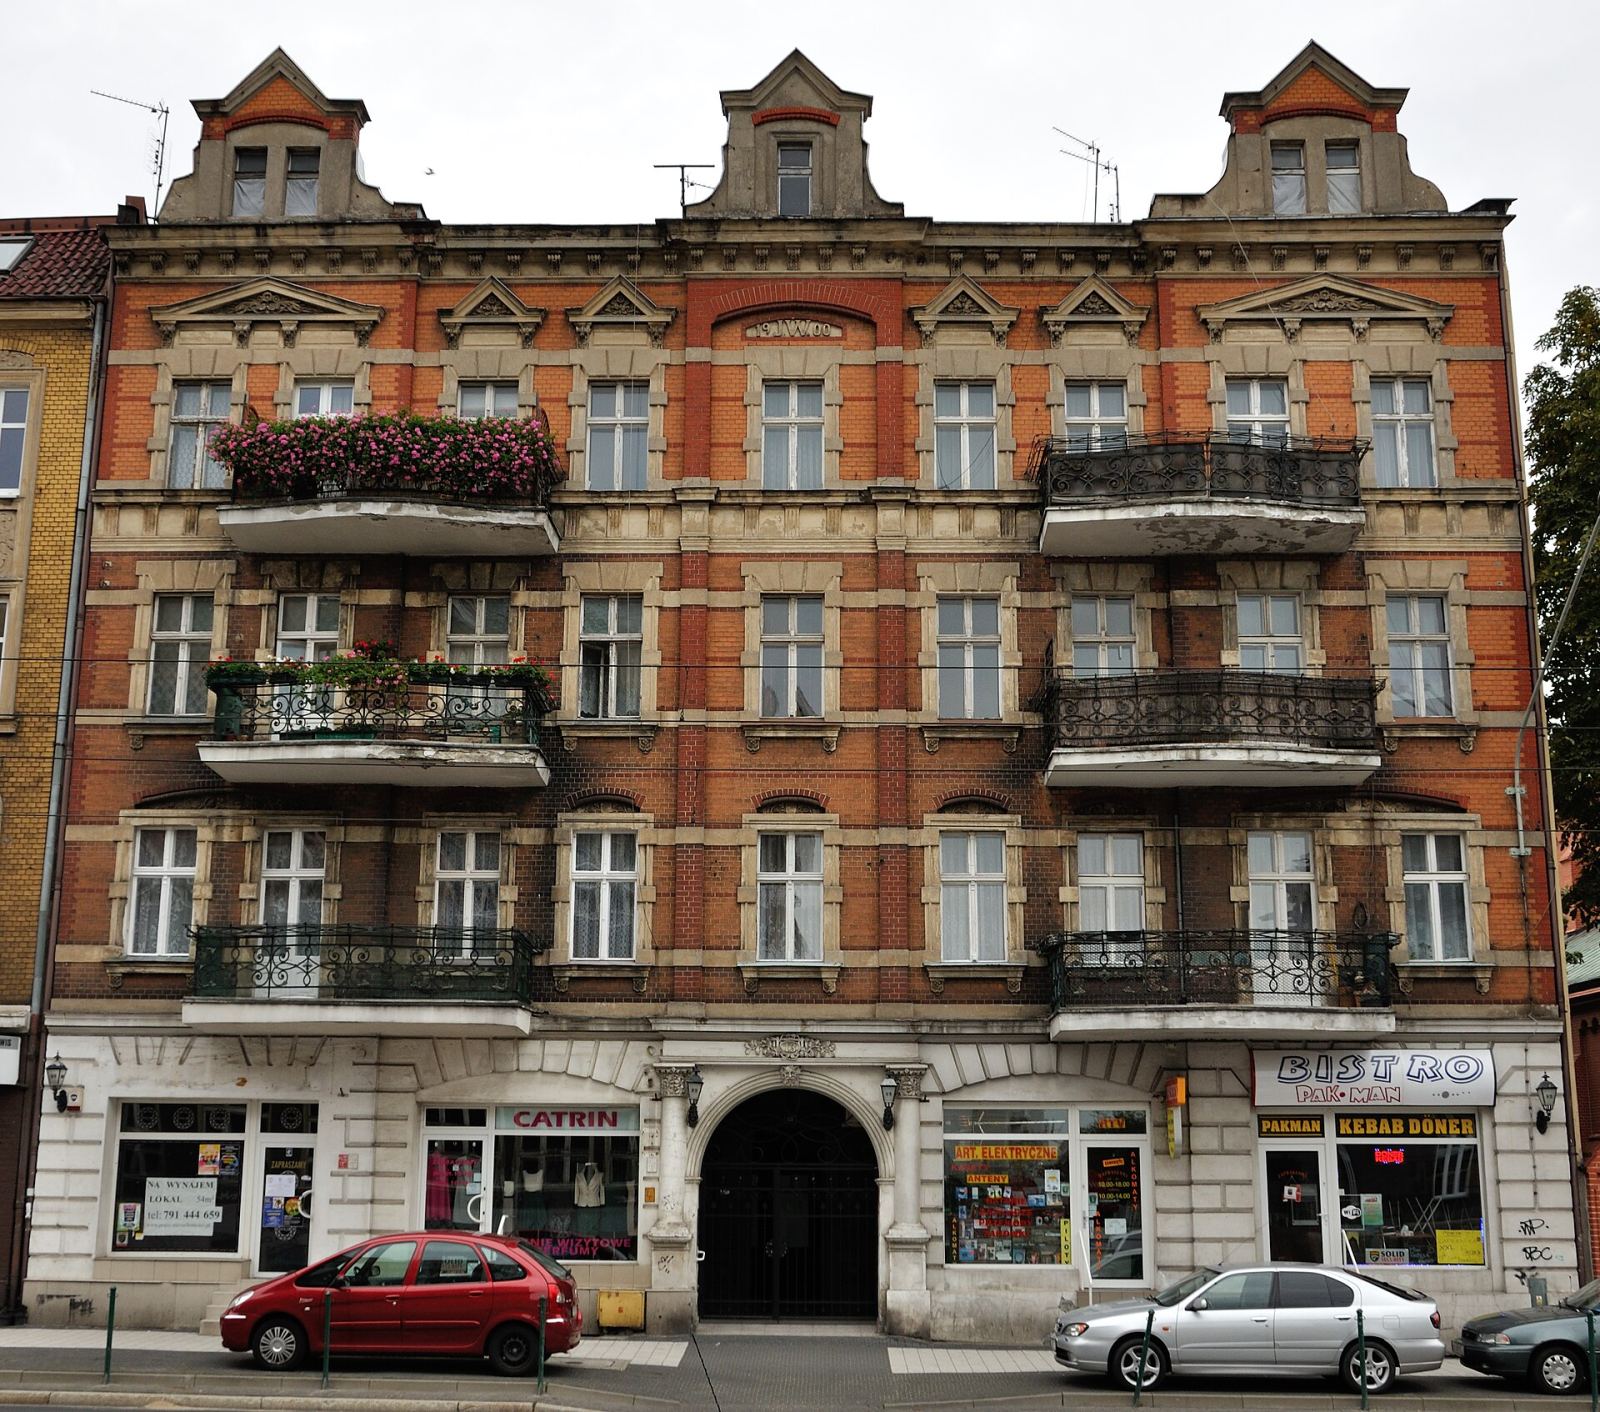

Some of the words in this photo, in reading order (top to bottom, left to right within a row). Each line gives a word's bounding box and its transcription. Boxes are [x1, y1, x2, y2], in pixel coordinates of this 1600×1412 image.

[755, 322, 770, 337] 19
[813, 323, 831, 337] 00
[1277, 1054, 1484, 1084] BISTRO
[513, 1111, 618, 1128] CATRIN
[1339, 1118, 1404, 1135] KEBAB
[1408, 1114, 1474, 1135] DÖNER
[1262, 1120, 1321, 1133] PAKMAN
[956, 1147, 978, 1159] ART.
[981, 1147, 1057, 1159] ELEKTRYCZNE
[968, 1175, 1007, 1183] ANTENY
[1130, 1151, 1138, 1211] ALKOMATY
[149, 1195, 182, 1203] LOKAL
[163, 1211, 179, 1219] 791
[183, 1211, 200, 1219] 444
[203, 1211, 220, 1219] 659
[558, 1238, 632, 1247] WIZYTOWE
[544, 1247, 599, 1256] ERFUMY
[1381, 1250, 1405, 1258] SOLID
